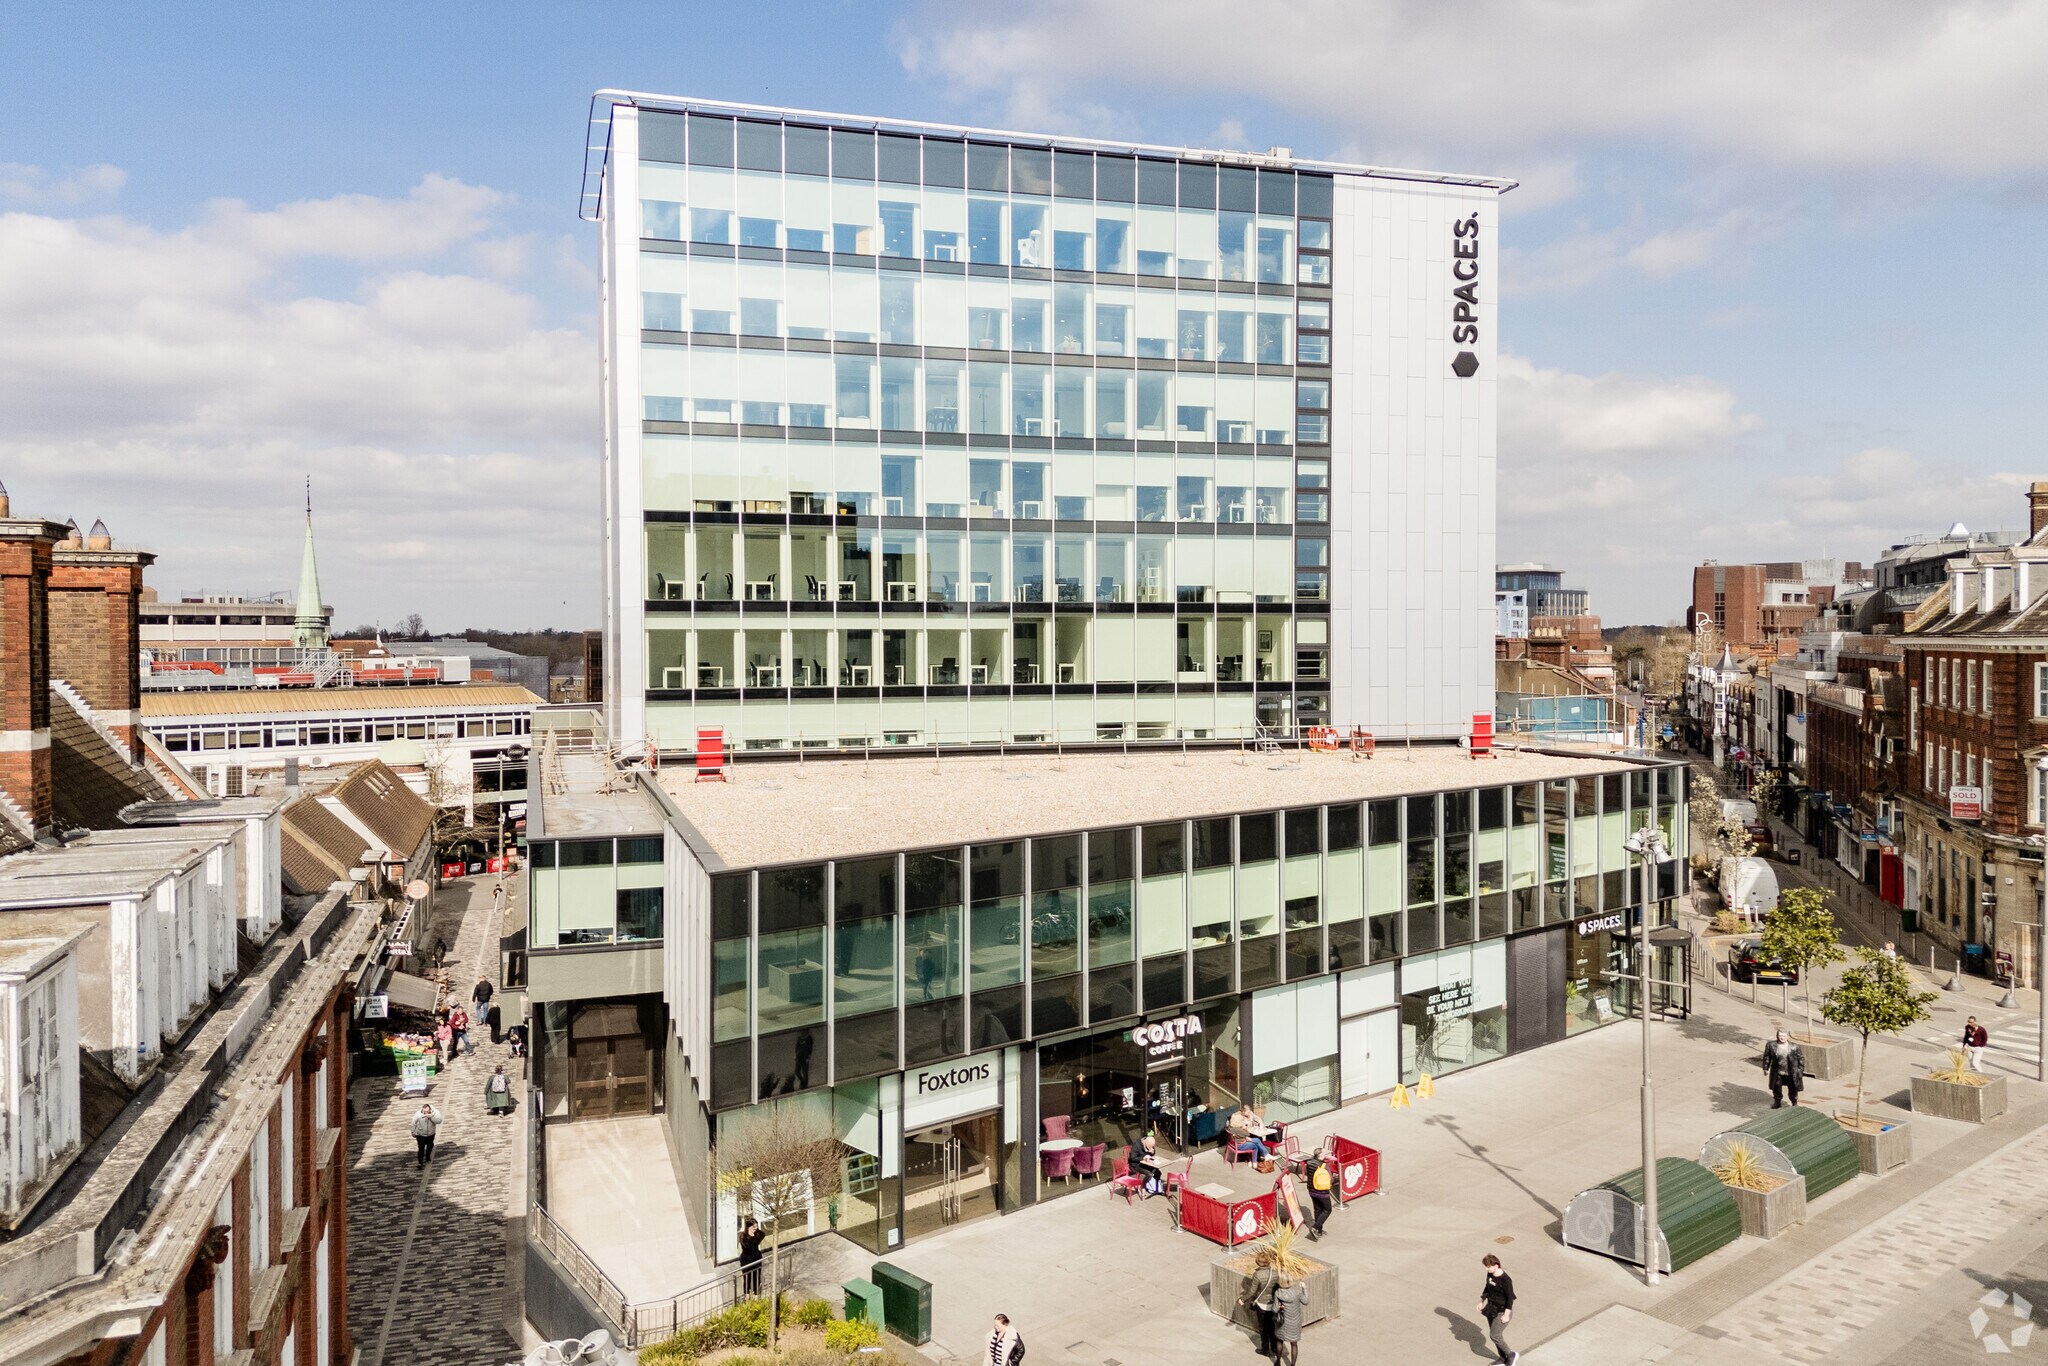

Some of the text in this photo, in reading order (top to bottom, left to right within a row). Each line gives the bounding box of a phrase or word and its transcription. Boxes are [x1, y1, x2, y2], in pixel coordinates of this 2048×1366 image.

[1439, 977, 1472, 992] WHAT YOU
[1428, 994, 1441, 1004] SEE
[1442, 989, 1459, 1001] HERE
[1426, 1005, 1436, 1015] BE
[1436, 1001, 1454, 1012] YOUR
[1454, 997, 1469, 1008] NEW
[1132, 1014, 1203, 1046] COSTA
[1148, 1040, 1184, 1056] COFFEE
[918, 1063, 989, 1094] Foxtons
